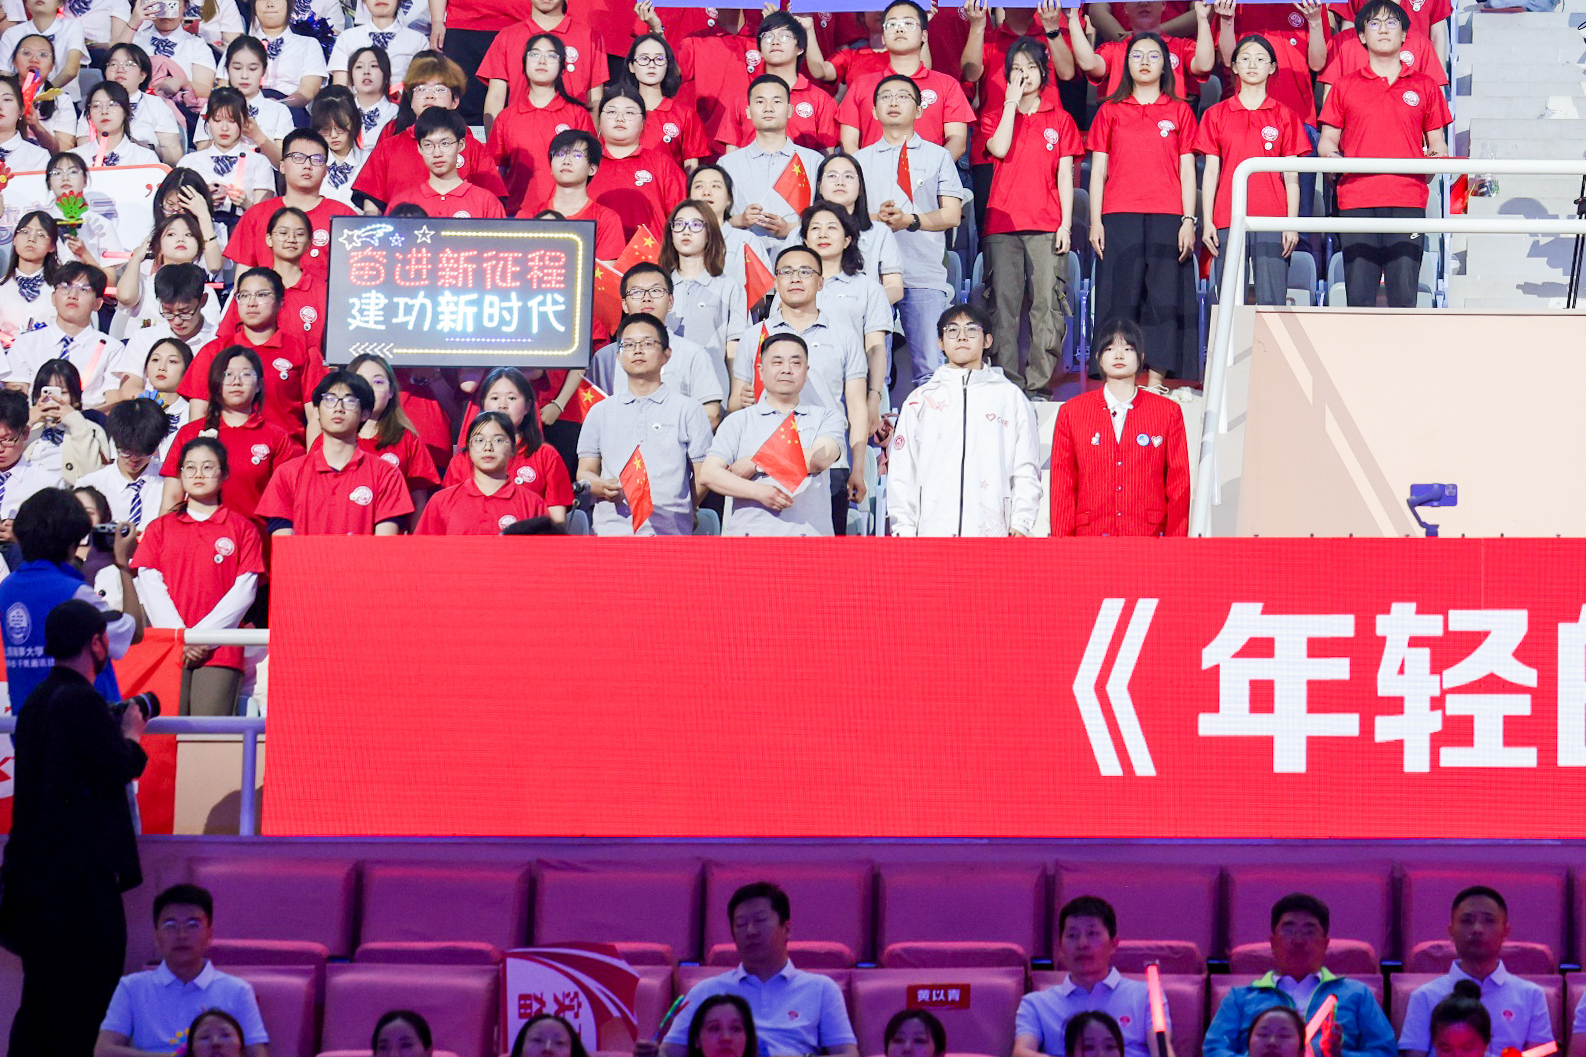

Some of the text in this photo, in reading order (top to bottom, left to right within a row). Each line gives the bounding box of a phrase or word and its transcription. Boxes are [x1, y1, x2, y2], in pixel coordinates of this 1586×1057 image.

[348, 246, 568, 290] 奋进新征程
[347, 289, 567, 334] 建功新时代
